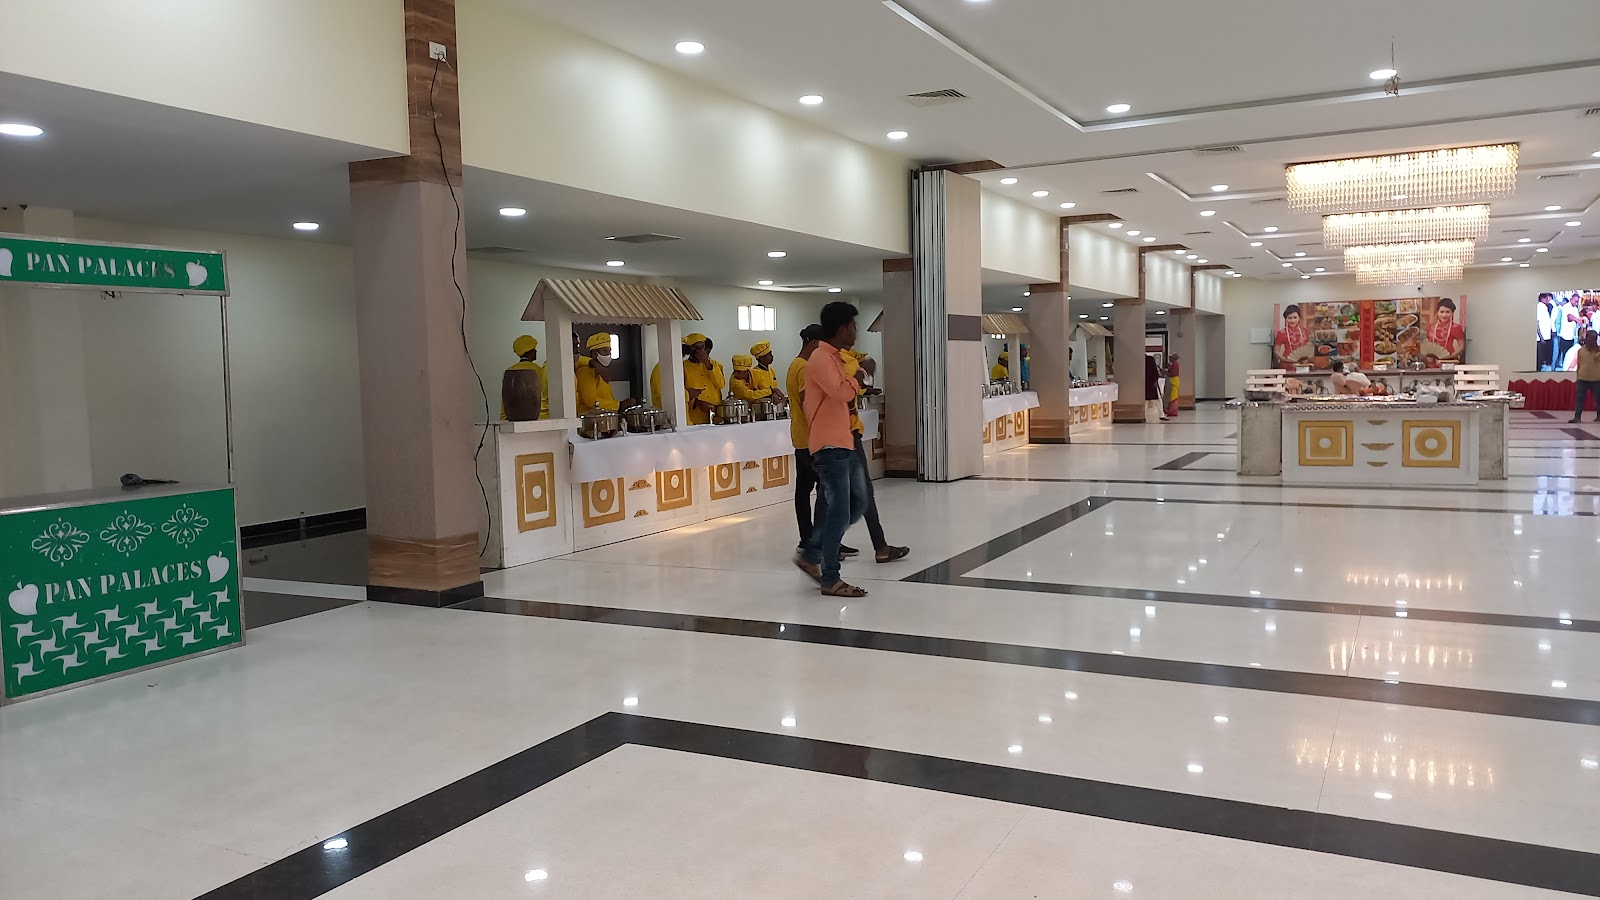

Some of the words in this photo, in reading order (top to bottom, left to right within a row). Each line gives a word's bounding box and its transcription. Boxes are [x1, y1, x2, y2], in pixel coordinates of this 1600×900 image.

[27, 252, 70, 273] PAN
[78, 256, 176, 279] PALACES
[44, 577, 92, 604] PAN
[100, 560, 203, 594] PALACES
